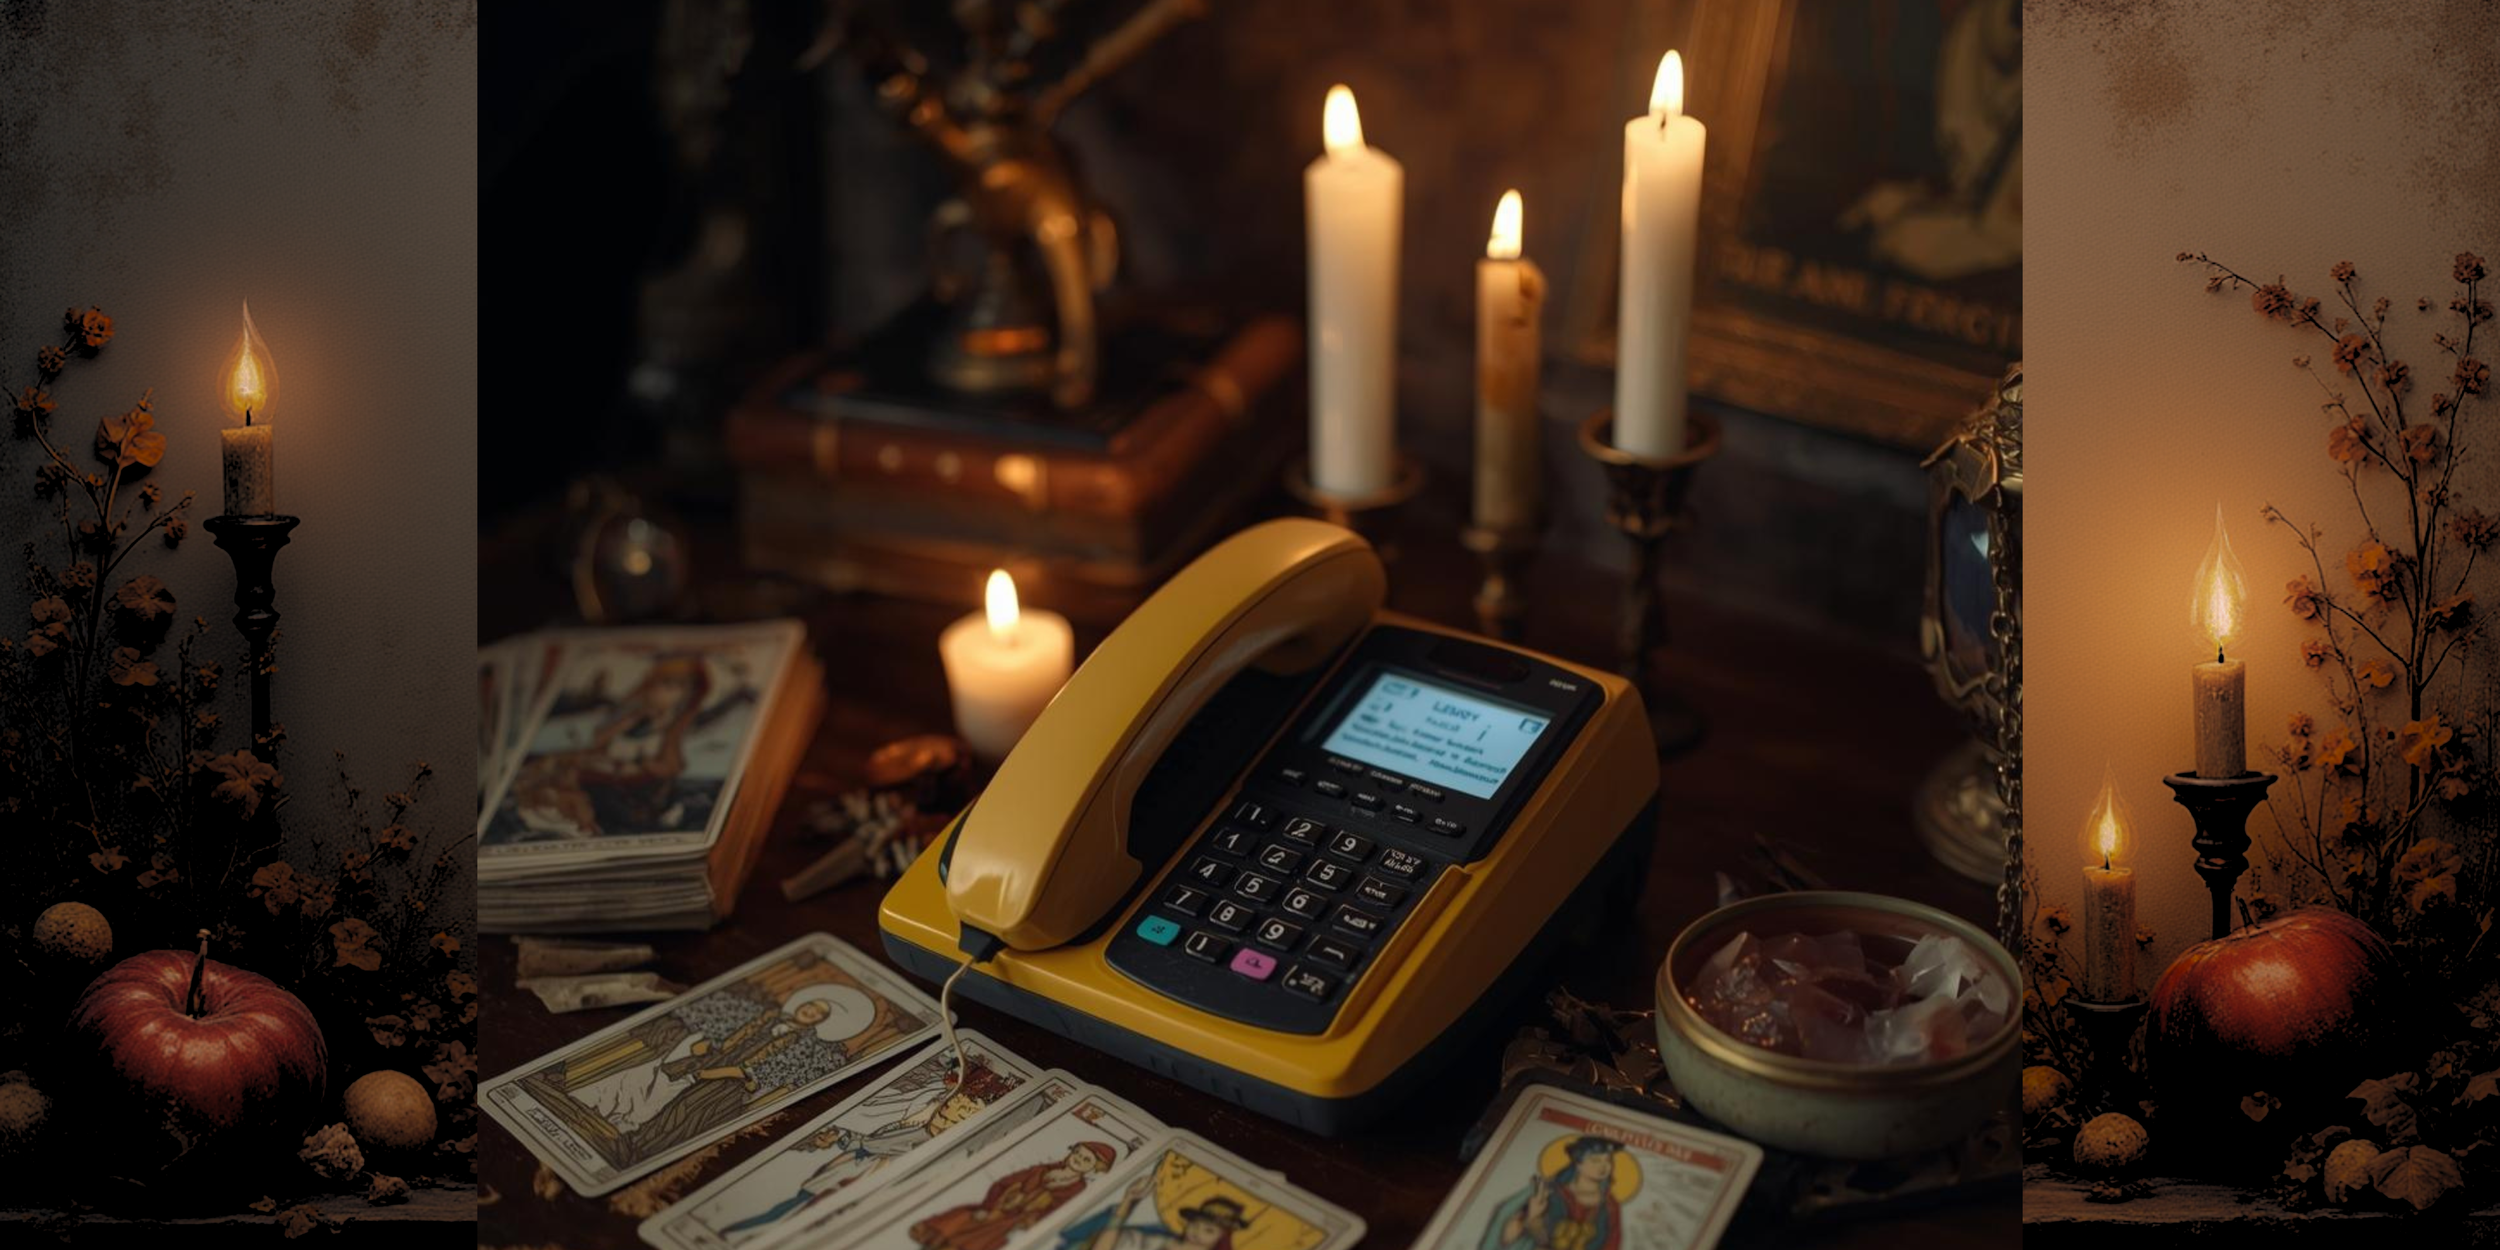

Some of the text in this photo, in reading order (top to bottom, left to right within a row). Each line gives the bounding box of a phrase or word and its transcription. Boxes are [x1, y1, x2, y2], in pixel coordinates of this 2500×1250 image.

[1245, 878, 1264, 893] 5
[1292, 894, 1310, 909] 6
[1219, 906, 1236, 922] 8
[1264, 923, 1285, 940] 9
